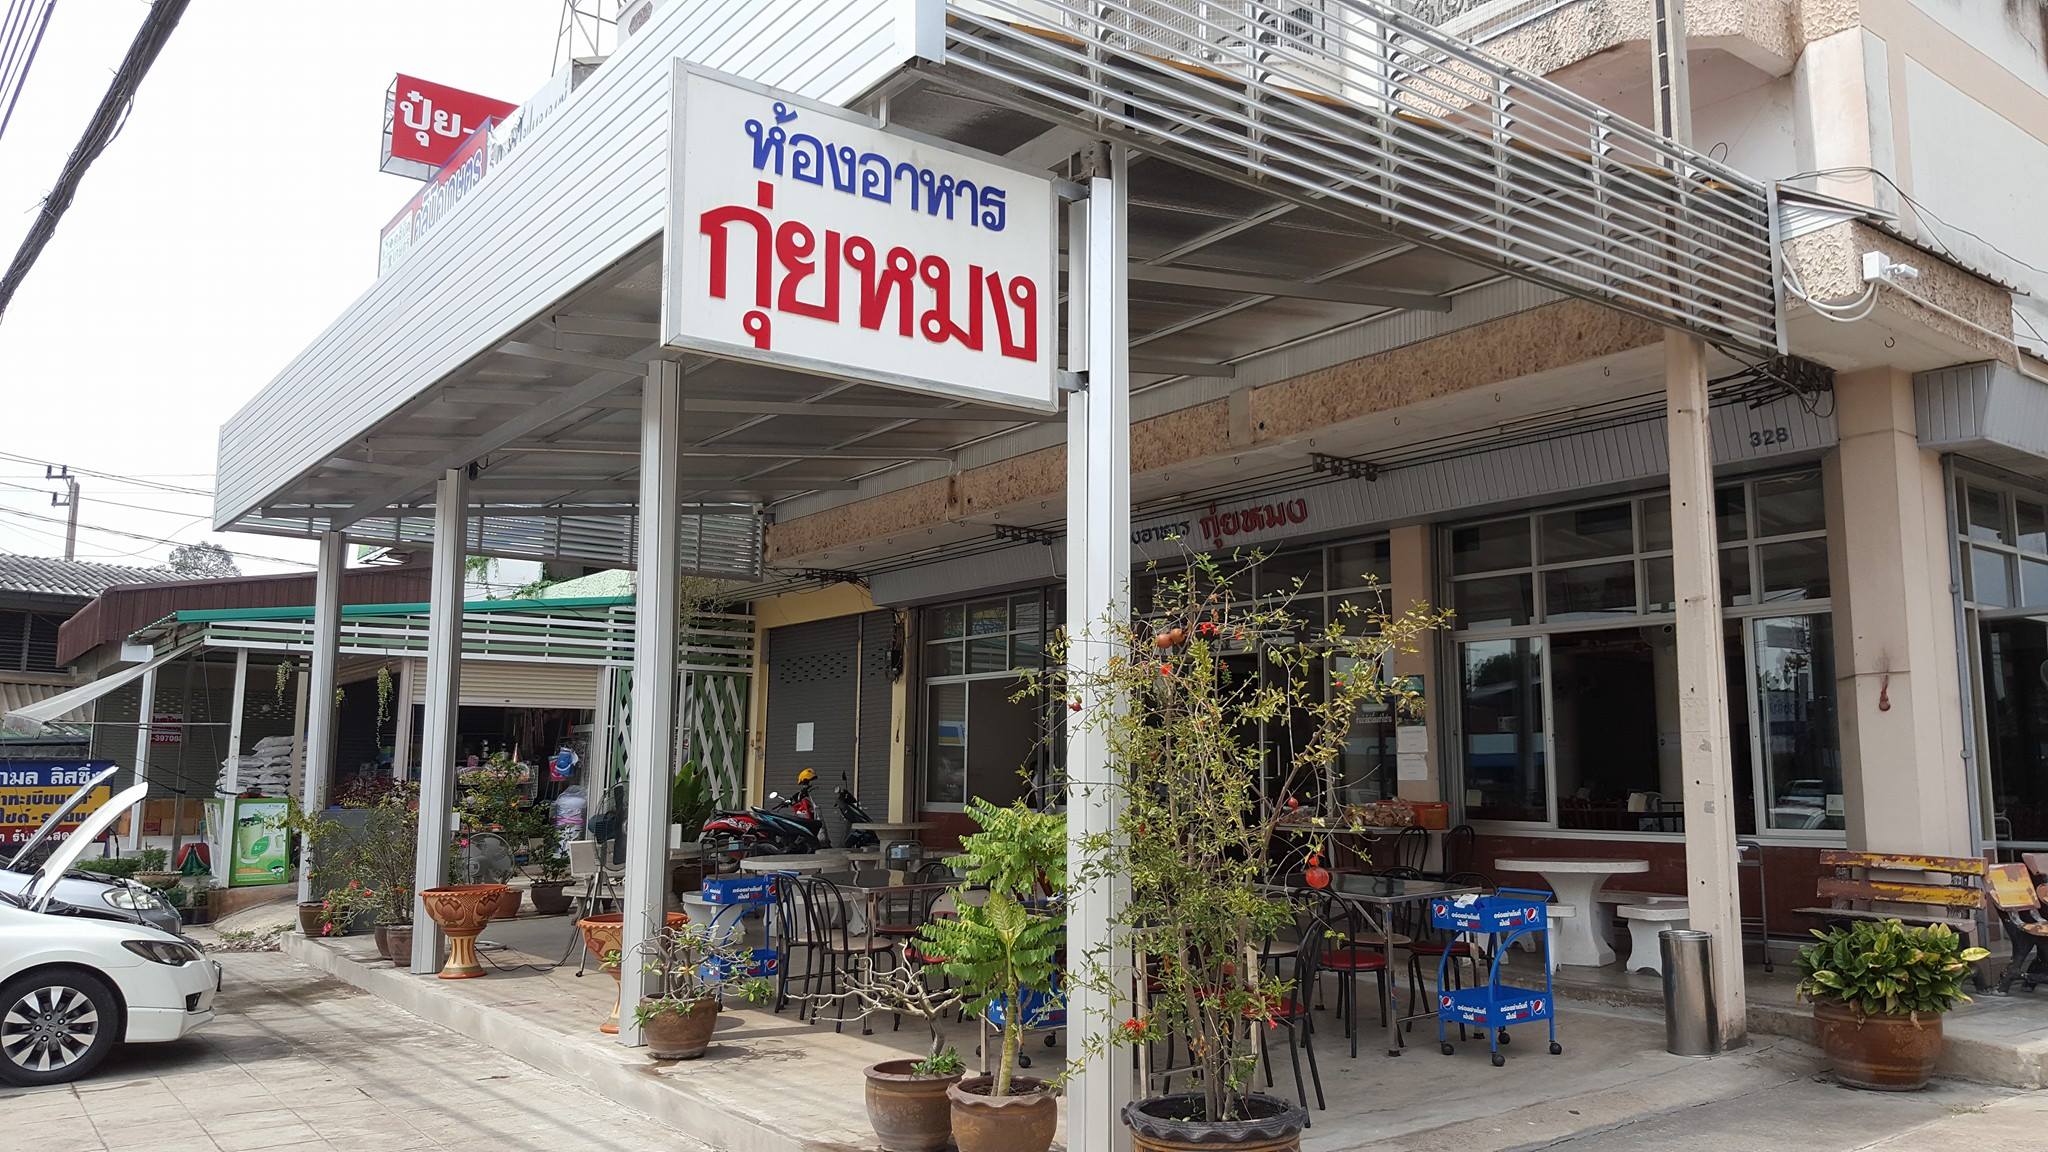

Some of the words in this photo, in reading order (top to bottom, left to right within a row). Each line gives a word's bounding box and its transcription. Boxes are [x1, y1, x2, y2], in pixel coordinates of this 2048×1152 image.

[744, 101, 1006, 232] ห้องอาหาร
[699, 180, 1038, 363] กุ่ยหมง
[1750, 427, 1789, 447] 328
[1130, 519, 1190, 544] งอาหาร
[1199, 498, 1309, 551] กุ่ยหมง
